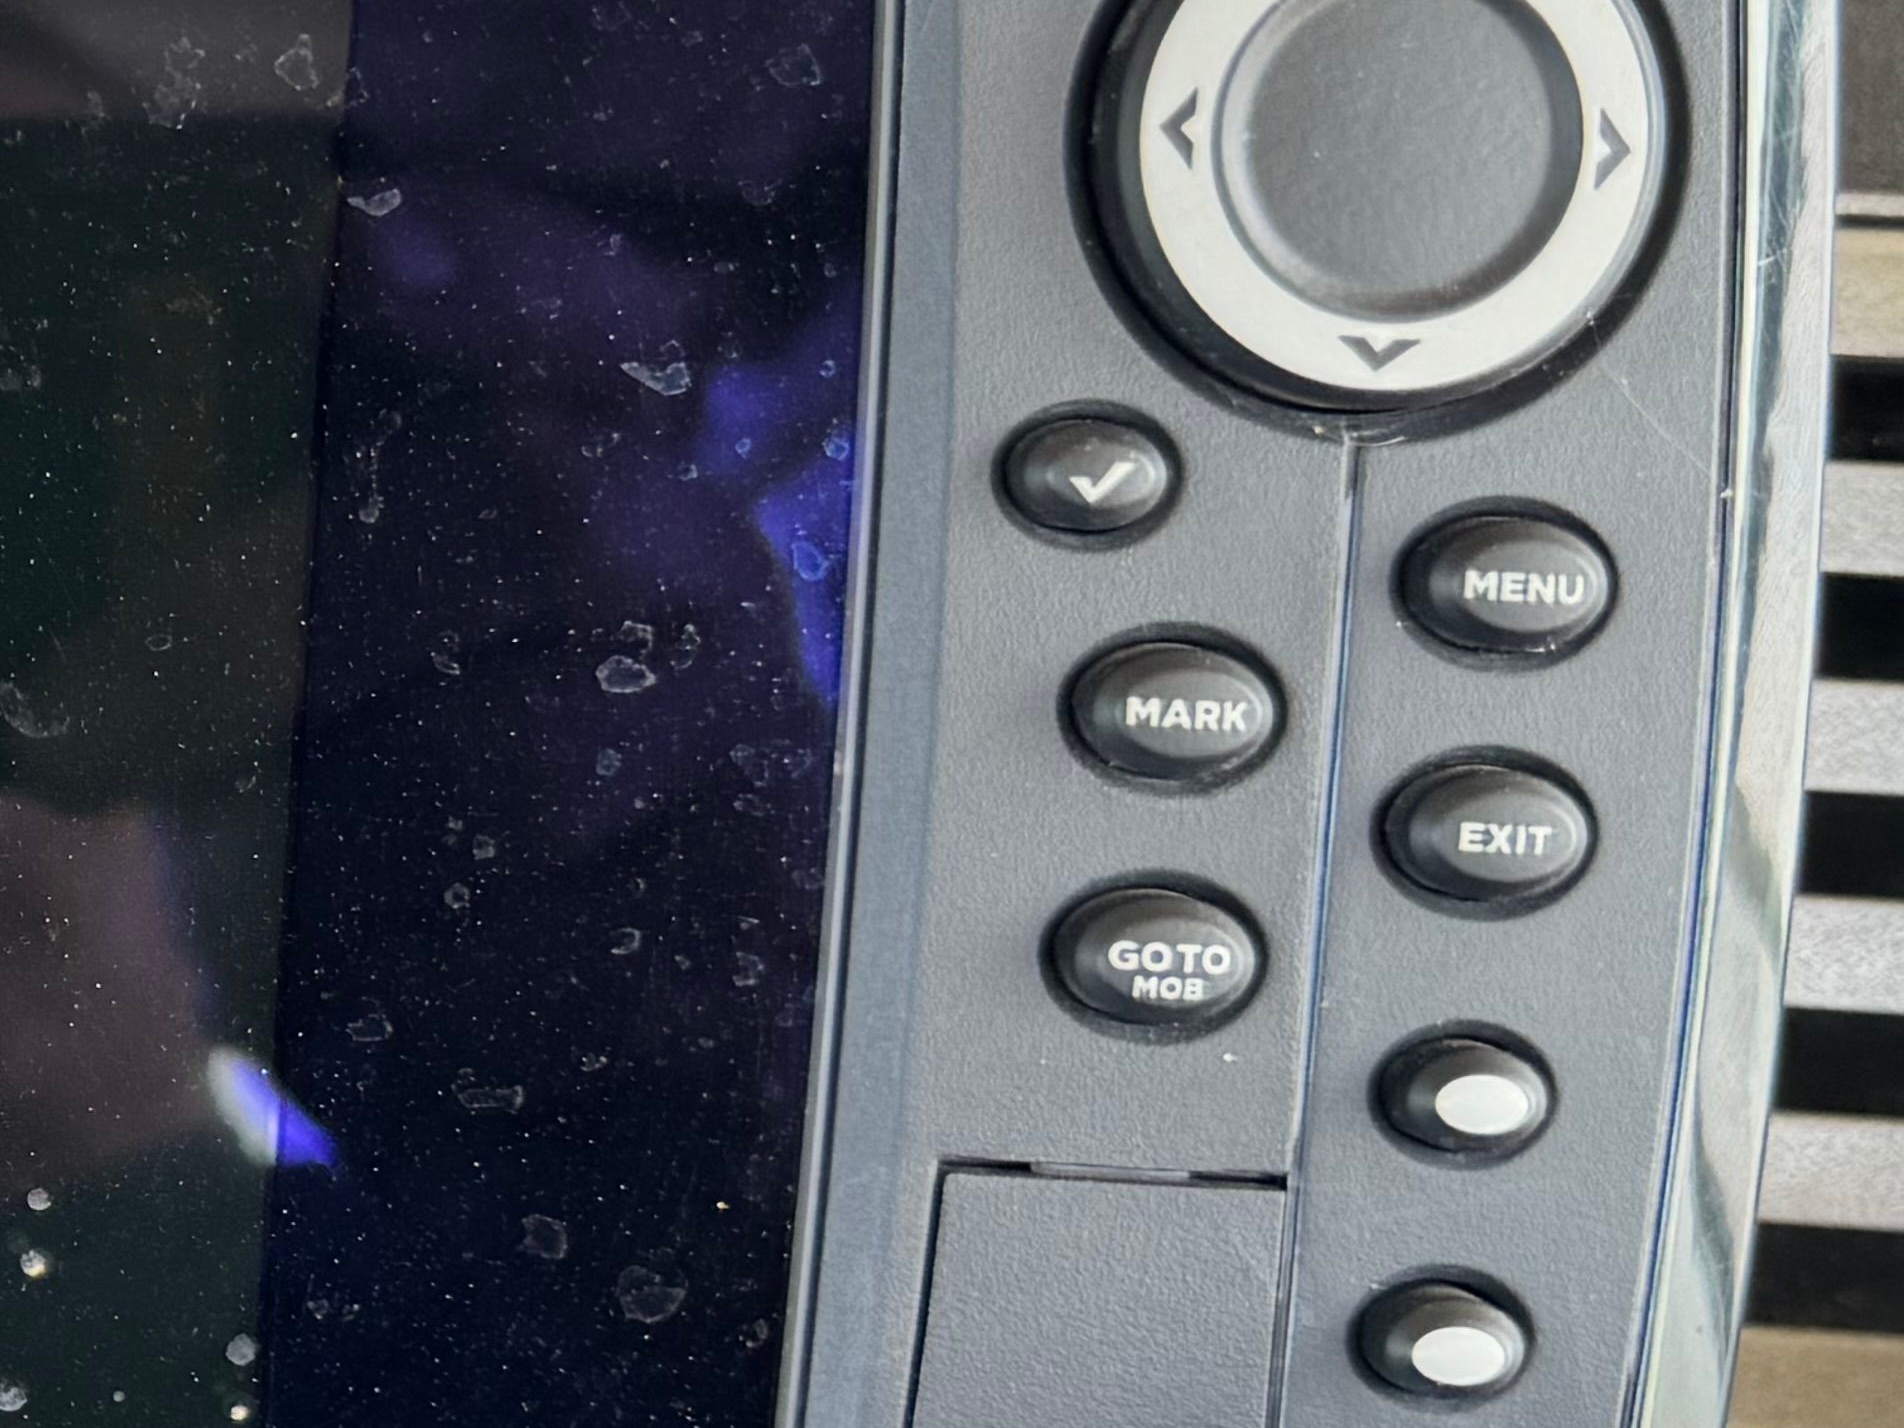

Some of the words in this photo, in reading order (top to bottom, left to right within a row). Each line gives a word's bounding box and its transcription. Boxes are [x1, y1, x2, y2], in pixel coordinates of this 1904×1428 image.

[1463, 568, 1587, 607] MENU
[1124, 696, 1251, 733] MARK
[1457, 821, 1554, 856] EXIT
[1132, 976, 1204, 1001] MOB
